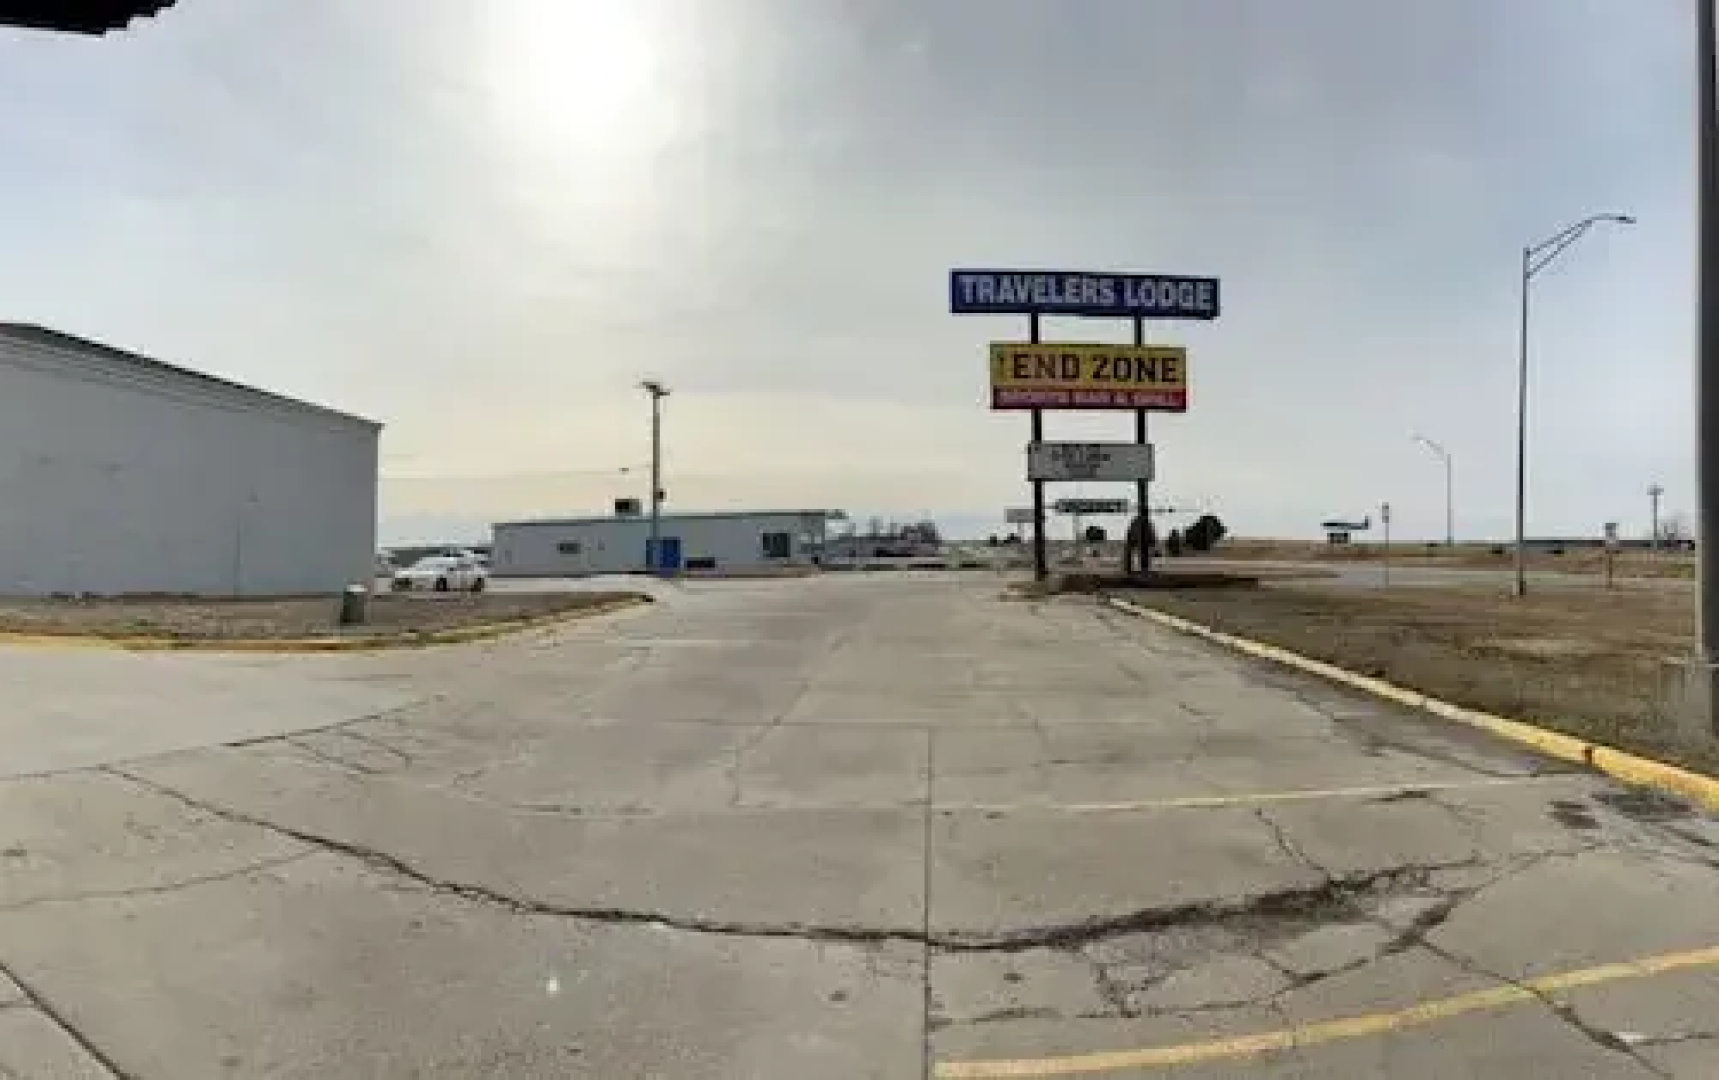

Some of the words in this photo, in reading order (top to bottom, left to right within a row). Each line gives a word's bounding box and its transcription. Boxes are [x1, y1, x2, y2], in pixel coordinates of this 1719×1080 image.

[959, 273, 1116, 305] TRAVELERS
[1123, 276, 1215, 308] LODGE
[1012, 352, 1081, 380] END
[1091, 355, 1181, 383] ZONE
